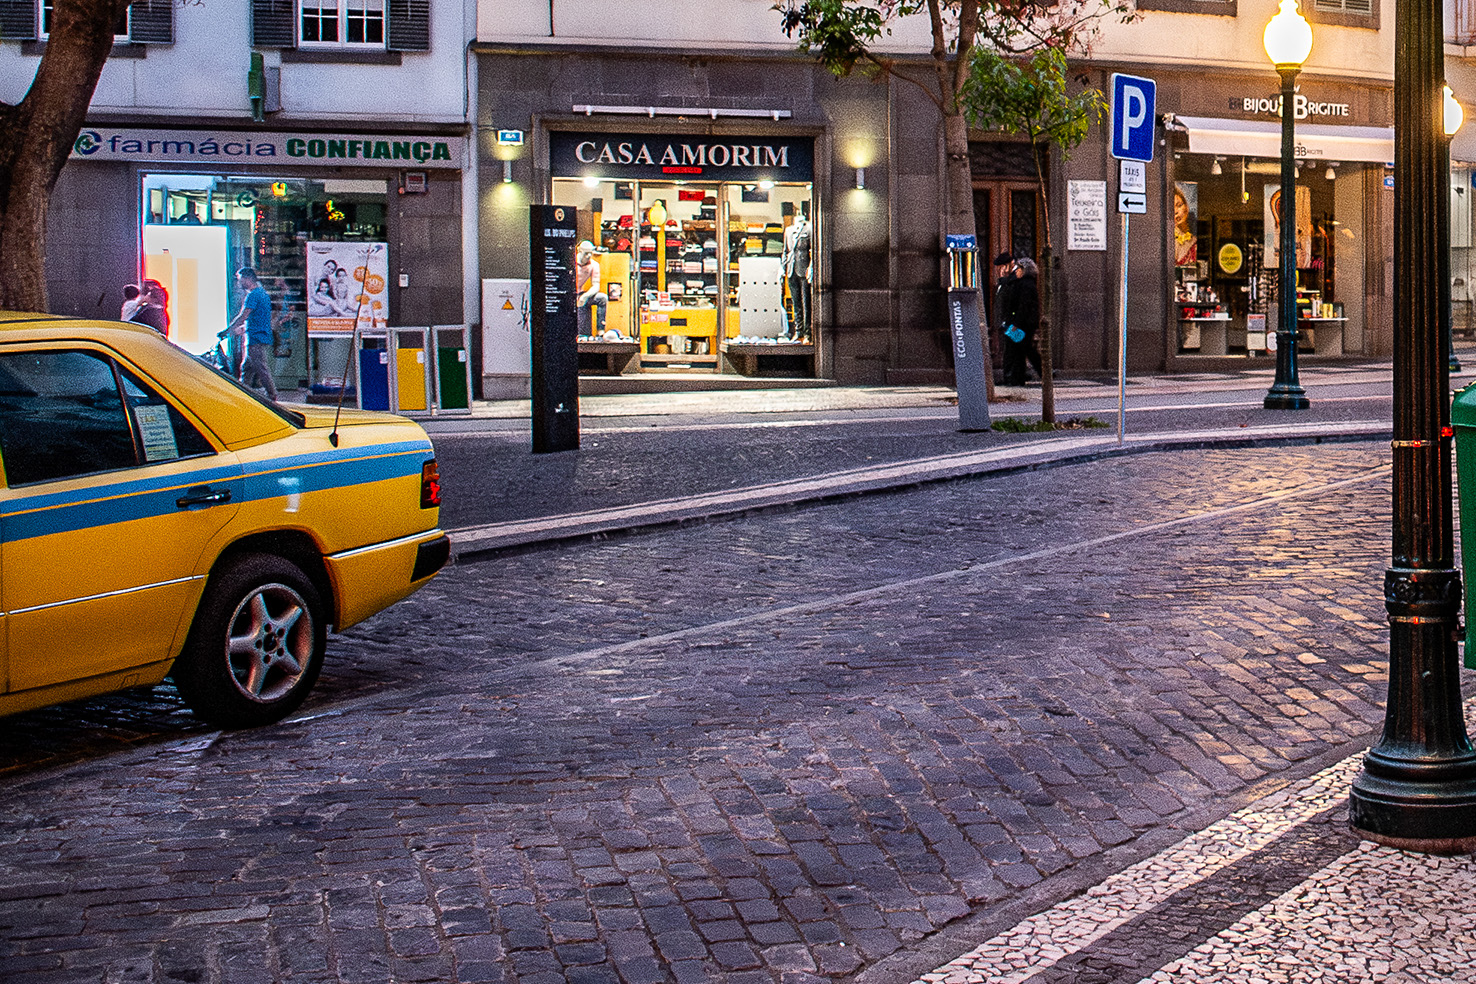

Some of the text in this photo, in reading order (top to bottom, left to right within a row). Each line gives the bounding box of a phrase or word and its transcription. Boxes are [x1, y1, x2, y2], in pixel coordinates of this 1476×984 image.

[1122, 84, 1147, 151] P
[1243, 97, 1279, 114] BIJOU
[106, 134, 452, 164] farmácia CONFIANÇA
[575, 141, 790, 167] CASA AMORIM
